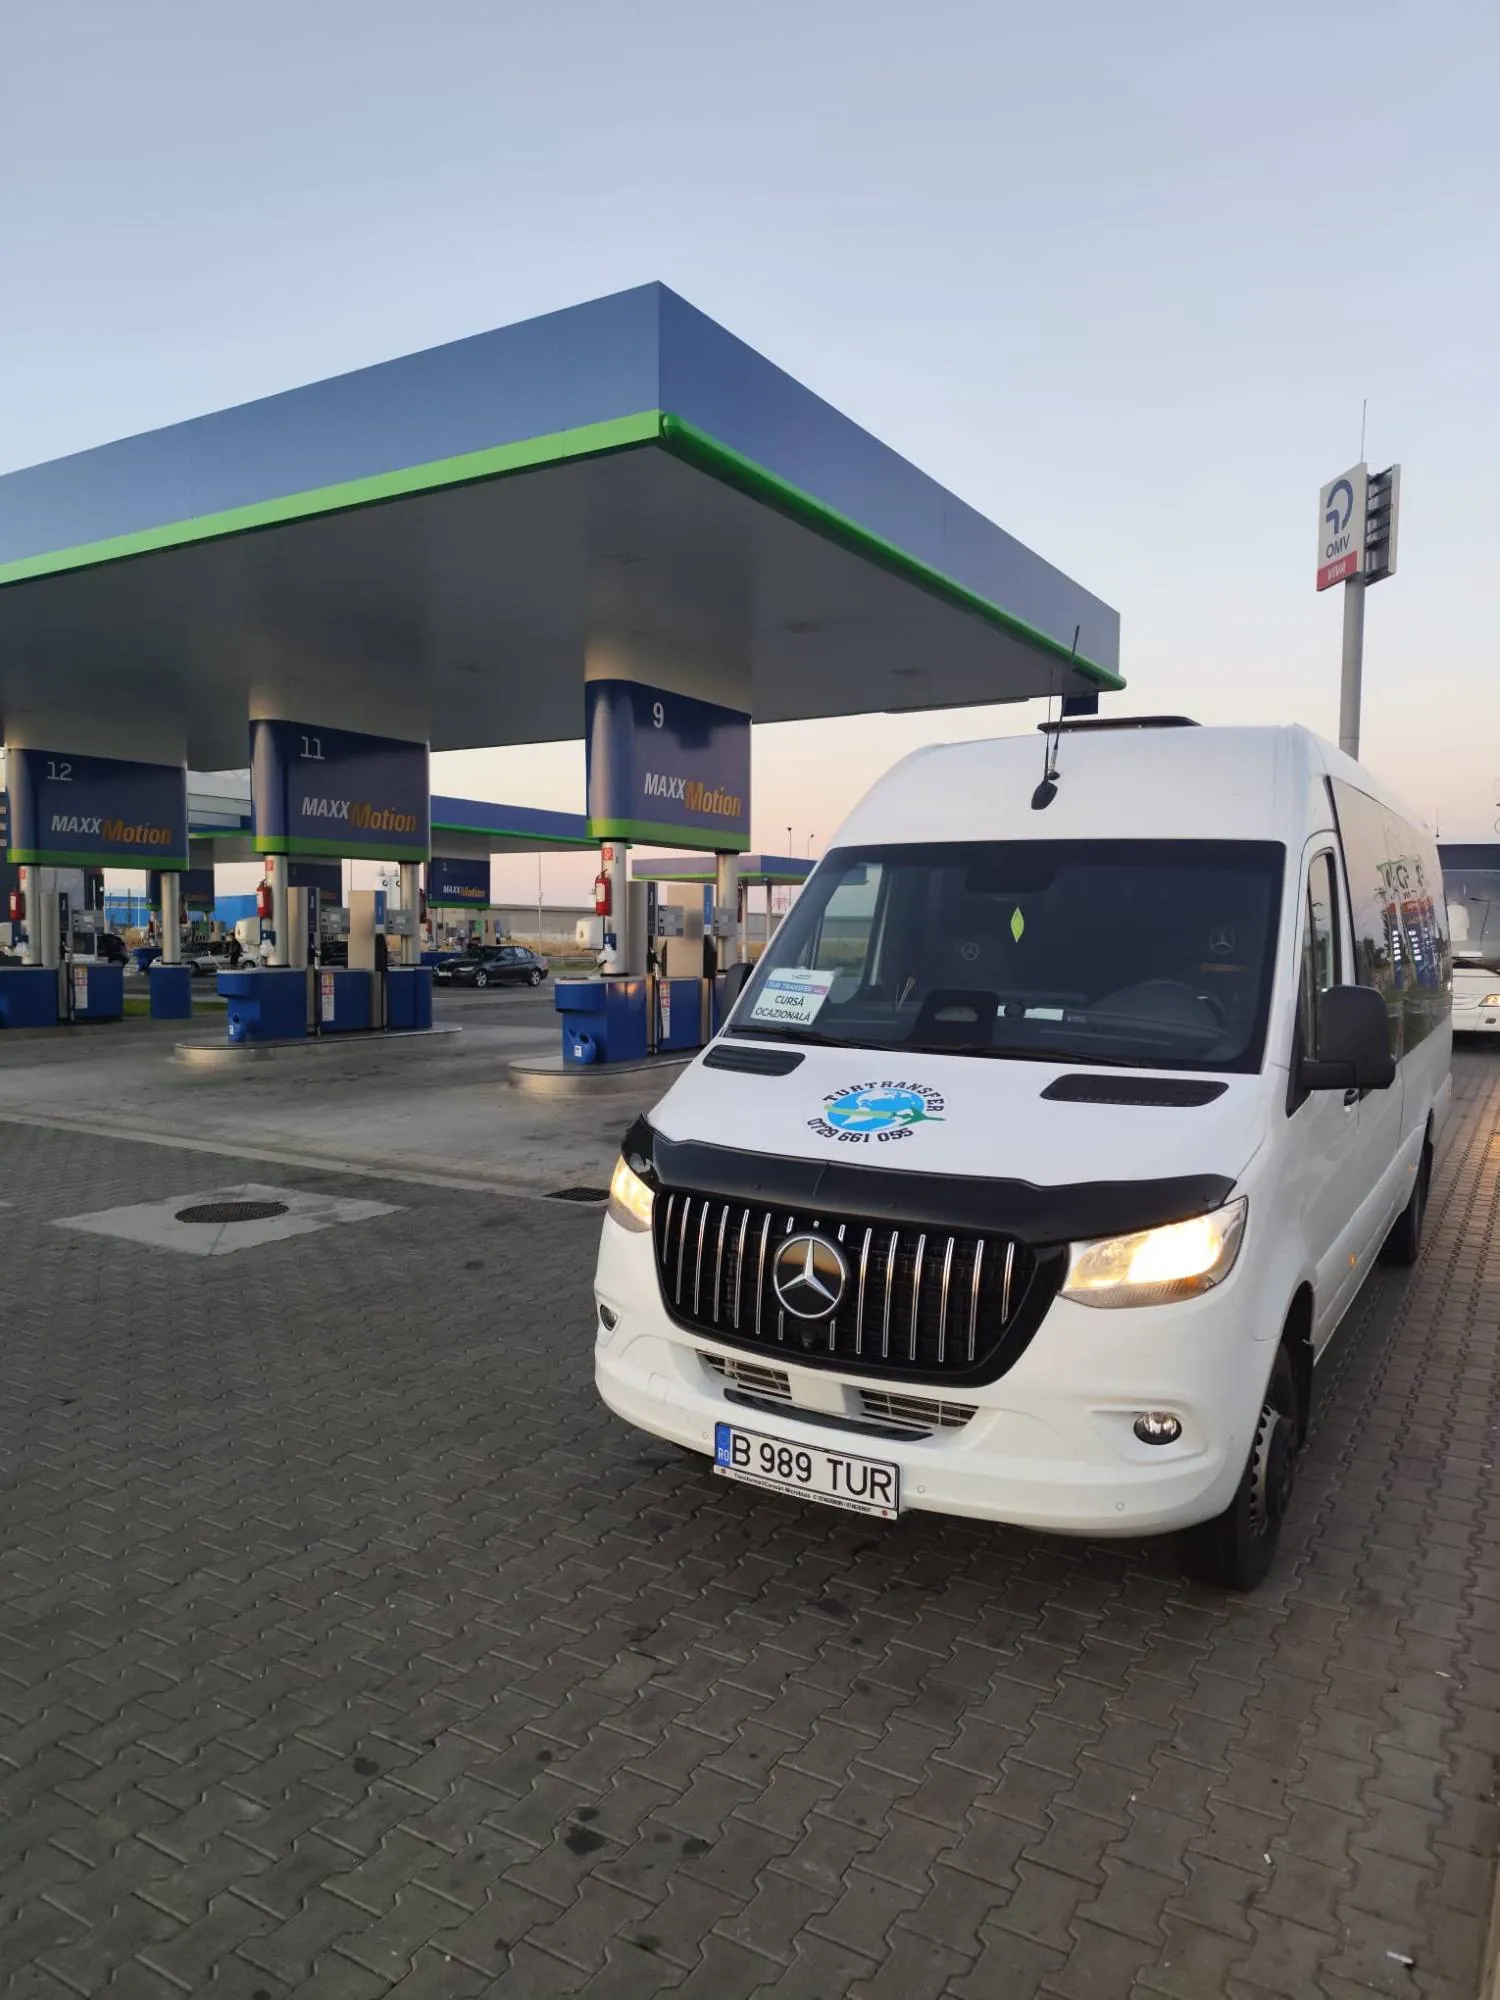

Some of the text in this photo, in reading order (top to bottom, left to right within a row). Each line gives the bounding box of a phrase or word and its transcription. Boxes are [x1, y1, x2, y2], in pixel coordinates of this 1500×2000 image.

[1326, 533, 1350, 558] OMV
[653, 702, 664, 728] 9
[300, 736, 325, 760] 11
[47, 761, 72, 781] 12
[644, 772, 741, 817] MAXX Motion
[301, 797, 416, 832] MAXX Motion
[51, 815, 172, 845] MAXX Motion
[807, 1118, 914, 1143] 0729 661 055
[718, 1448, 729, 1462] RO
[732, 1434, 751, 1467] B
[760, 1442, 812, 1483] 989
[826, 1457, 892, 1503] TUR
